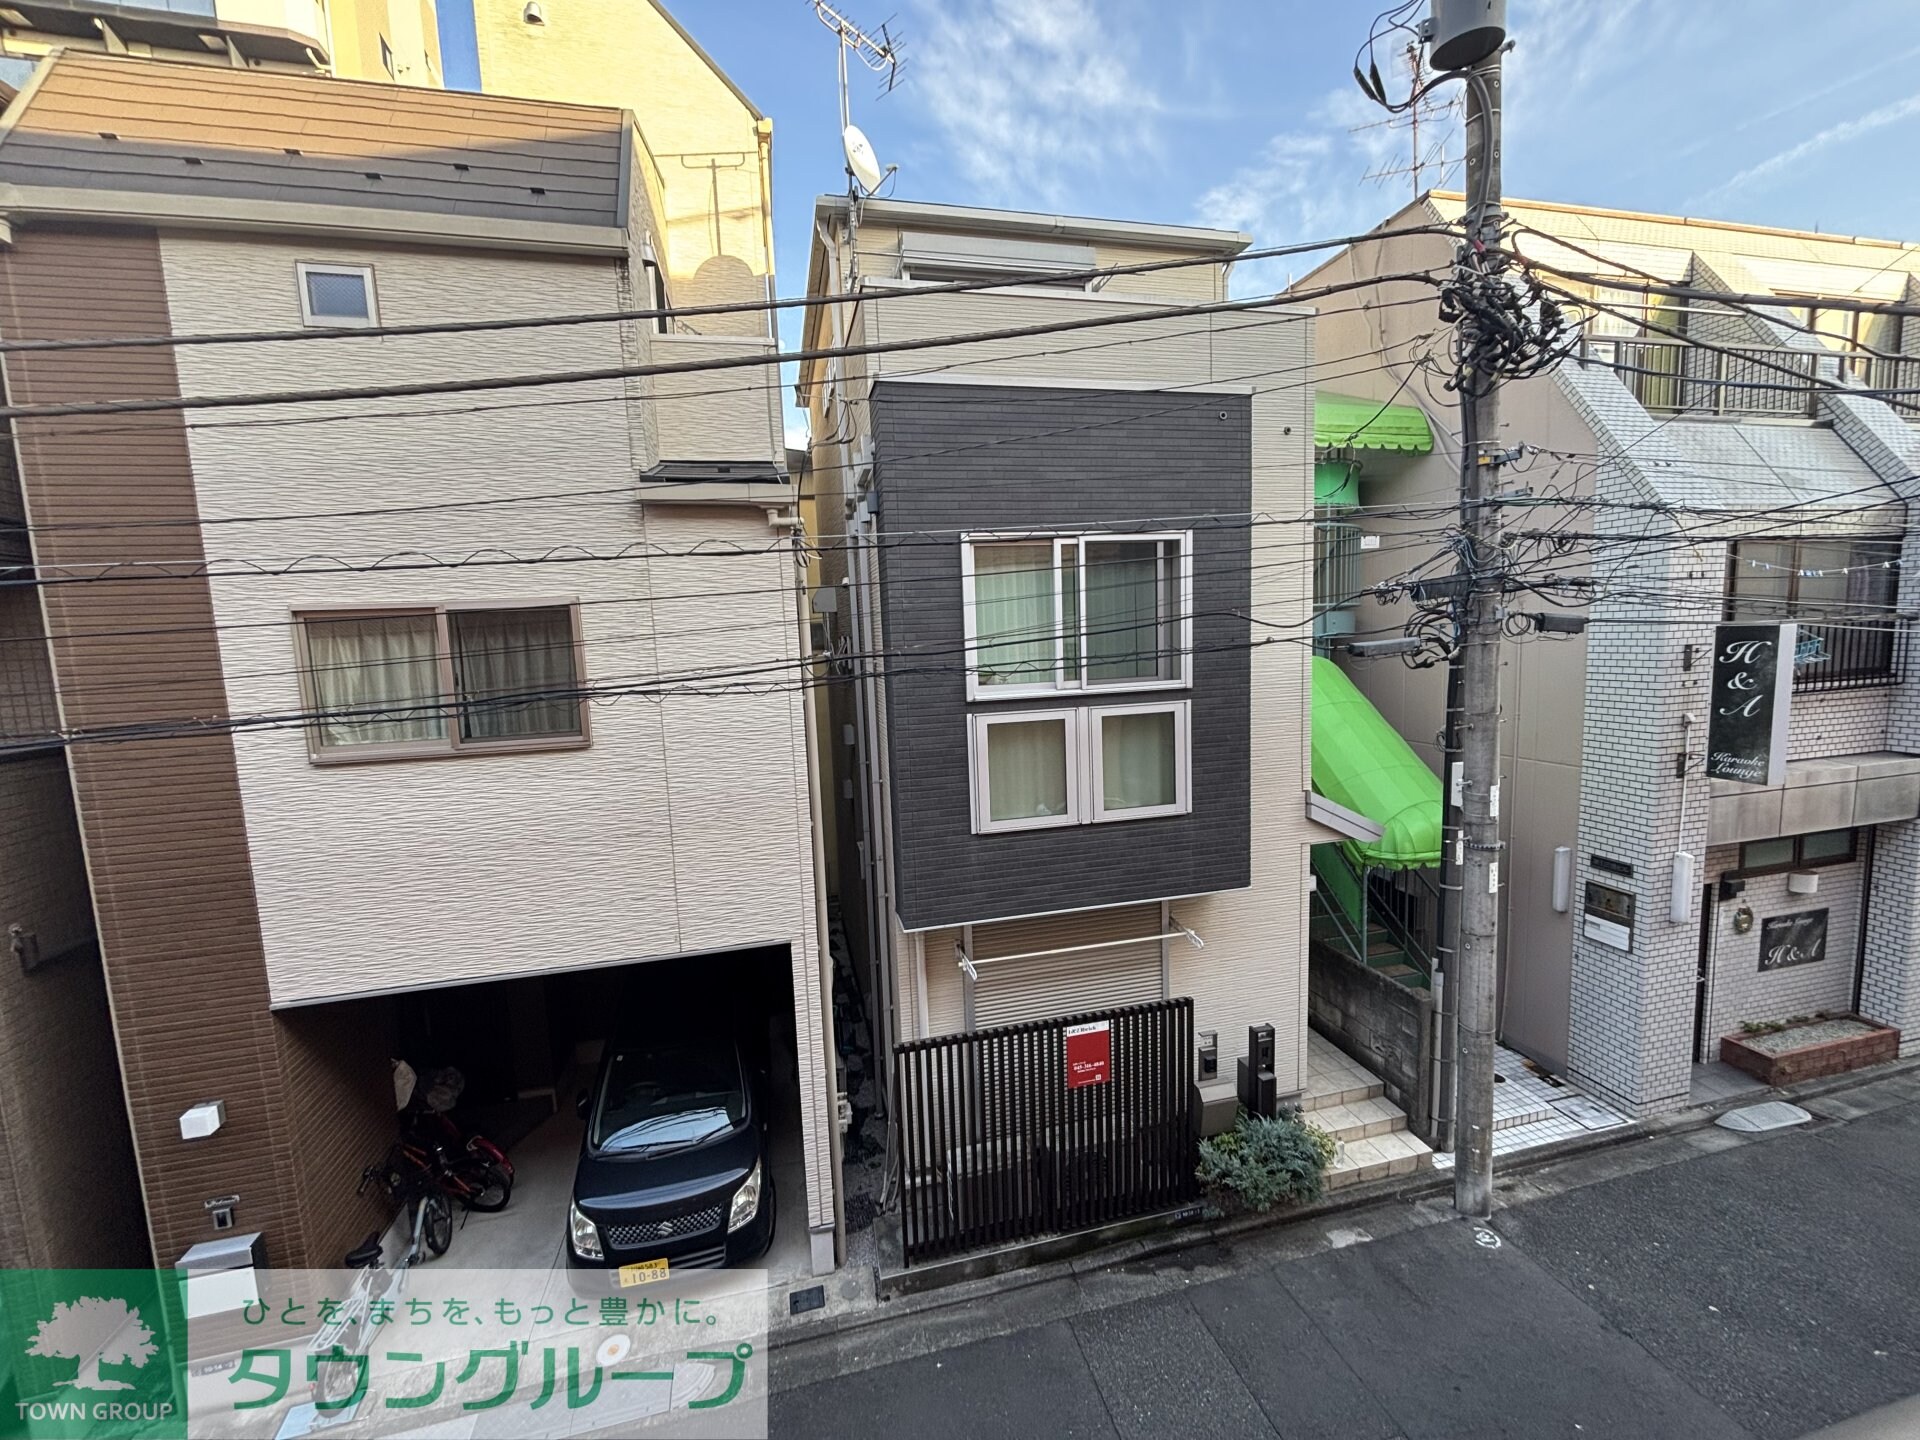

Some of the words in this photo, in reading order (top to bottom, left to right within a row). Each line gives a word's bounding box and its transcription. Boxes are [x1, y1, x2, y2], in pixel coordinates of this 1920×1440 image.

[1719, 640, 1772, 664] H
[1727, 671, 1758, 690] &
[1719, 694, 1764, 718] A
[1710, 751, 1765, 767] Karaoke
[1710, 762, 1762, 779] Lounge
[632, 1267, 667, 1284] 10-88
